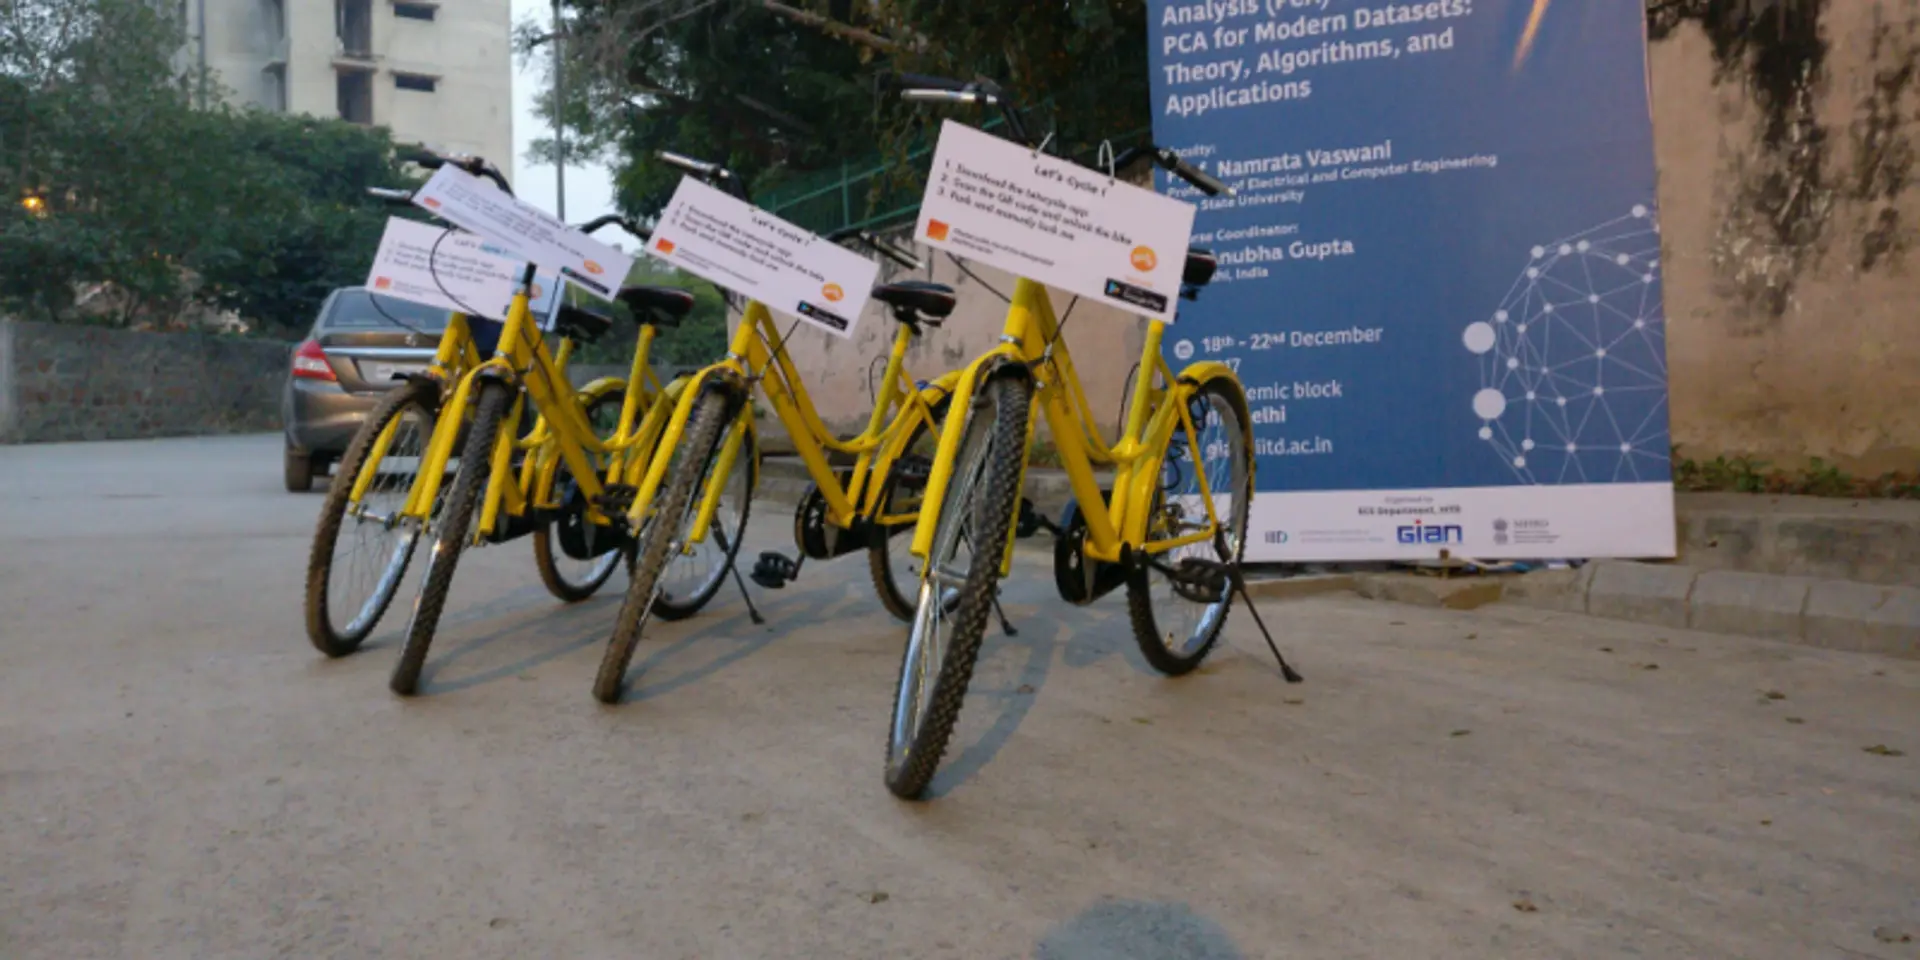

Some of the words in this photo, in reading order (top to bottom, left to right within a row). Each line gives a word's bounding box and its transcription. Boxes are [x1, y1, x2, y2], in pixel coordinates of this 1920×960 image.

[1162, 0, 1259, 26] Analysis
[1164, 31, 1208, 55] PCA
[1213, 26, 1248, 49] for
[1255, 14, 1346, 43] Modern
[1355, 0, 1472, 30] Datasets:
[1163, 58, 1250, 85] Theory,
[1257, 38, 1400, 74] Algorithms,
[1407, 27, 1454, 53] and
[1165, 80, 1311, 117] Applications
[1217, 153, 1302, 177] Namrata
[1306, 139, 1392, 167] Vaswani
[1248, 173, 1309, 190] Electrical
[1312, 168, 1338, 183] and
[1341, 162, 1409, 180] Computer
[1411, 154, 1498, 173] Engineering
[1201, 198, 1235, 210] State
[1238, 190, 1305, 206] University
[1217, 224, 1298, 241] Coordinator:
[1288, 238, 1355, 261] Gupta
[1236, 266, 1269, 279] India
[1290, 326, 1383, 347] December
[1293, 380, 1342, 399] block
